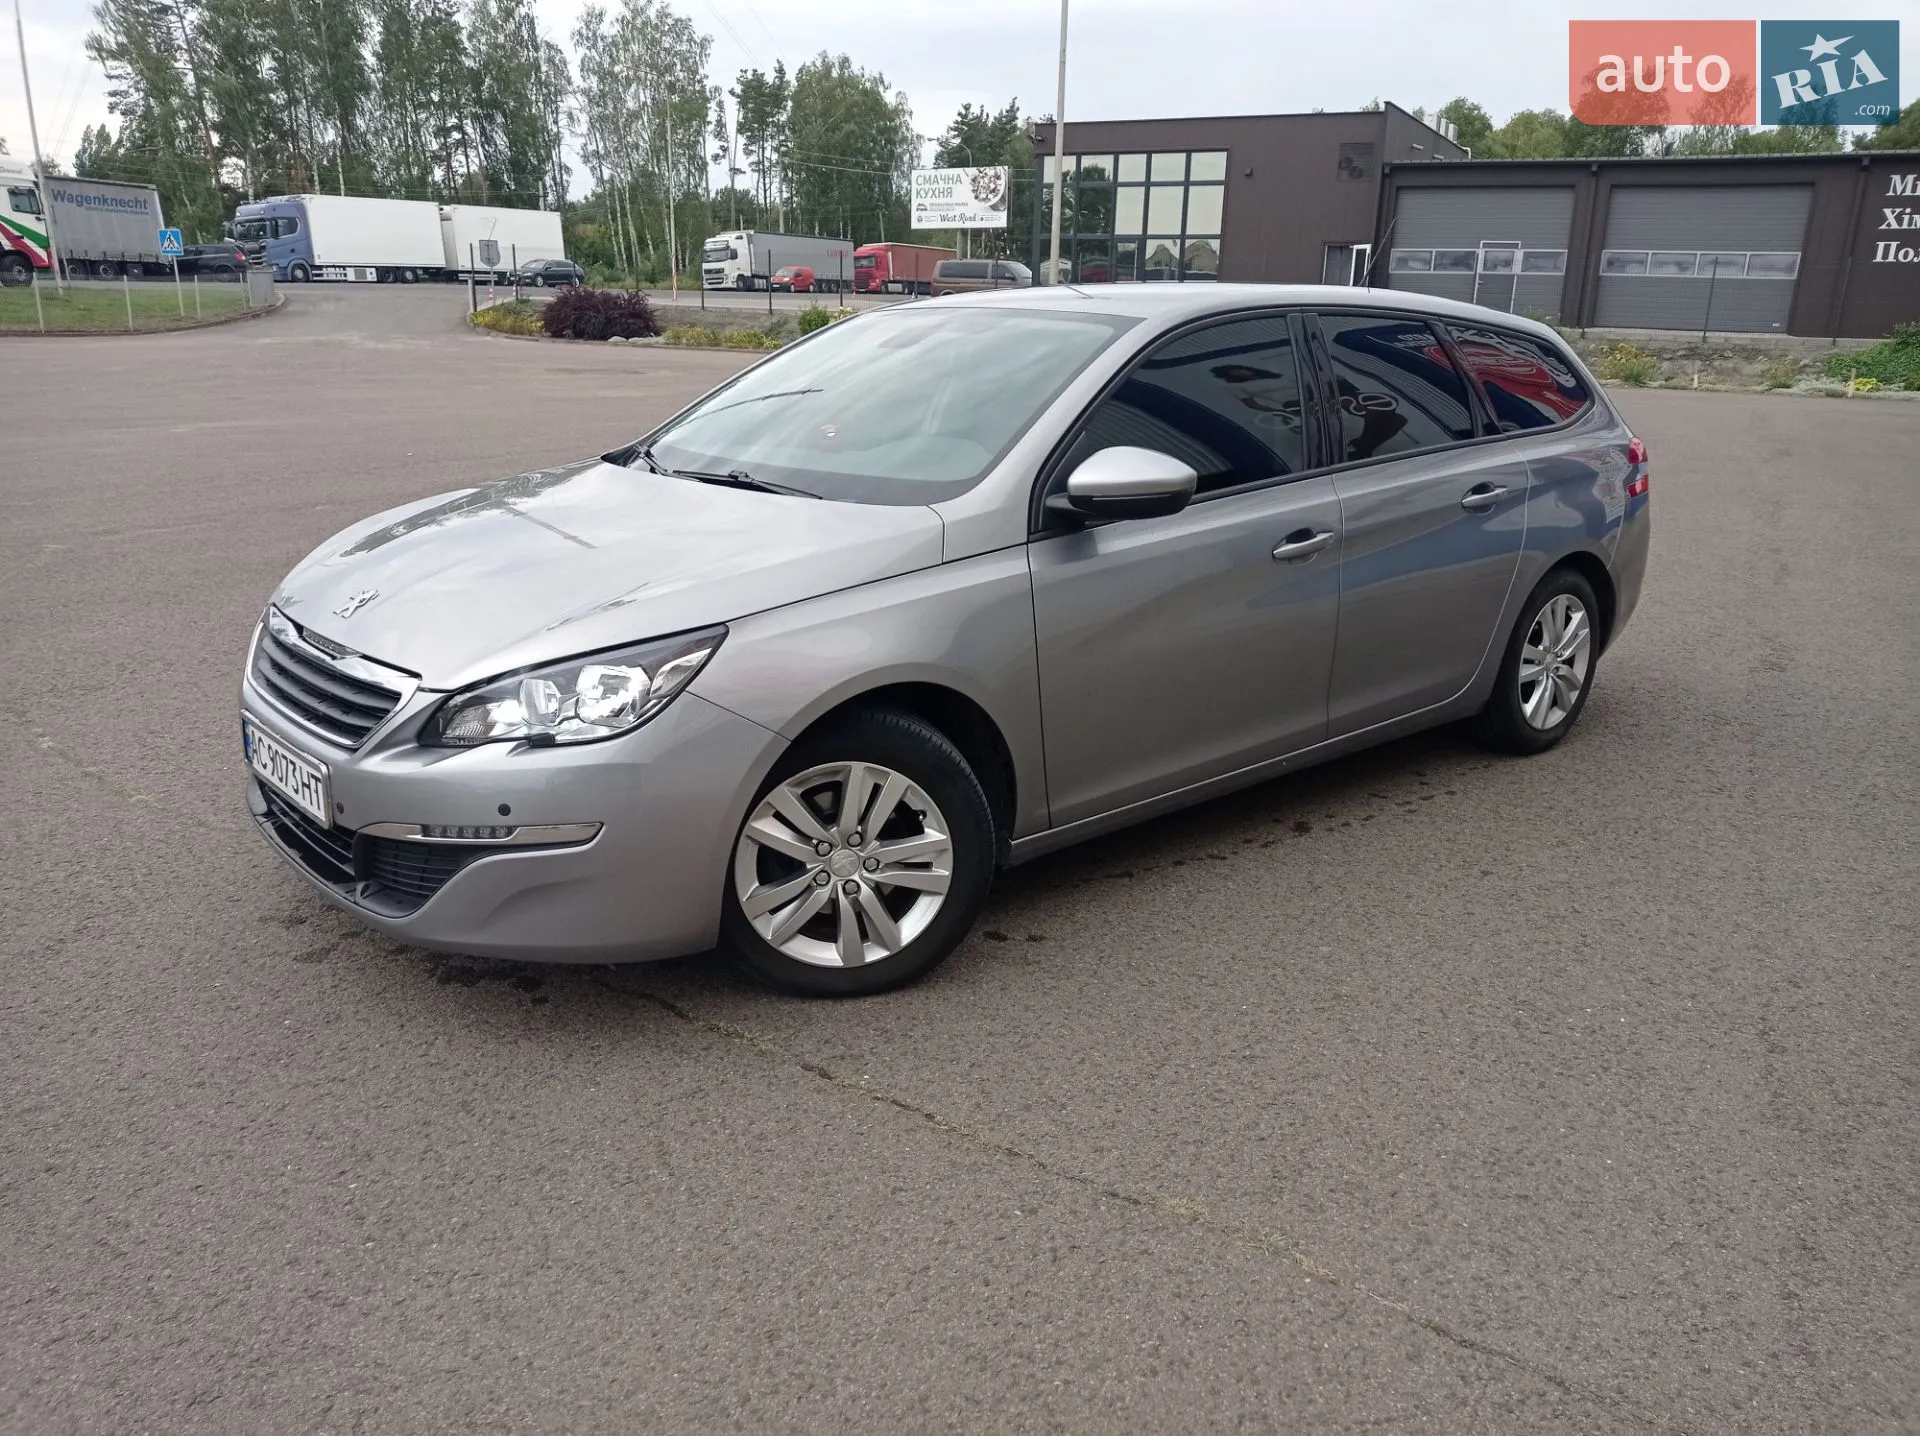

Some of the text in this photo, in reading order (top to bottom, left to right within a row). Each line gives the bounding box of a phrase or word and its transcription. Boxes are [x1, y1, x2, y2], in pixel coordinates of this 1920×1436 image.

[916, 173, 963, 186] СМАЧНА
[51, 188, 148, 210] Wagenknecht
[916, 187, 953, 199] КУХНЯ
[939, 213, 957, 223] West
[957, 212, 976, 224] Road
